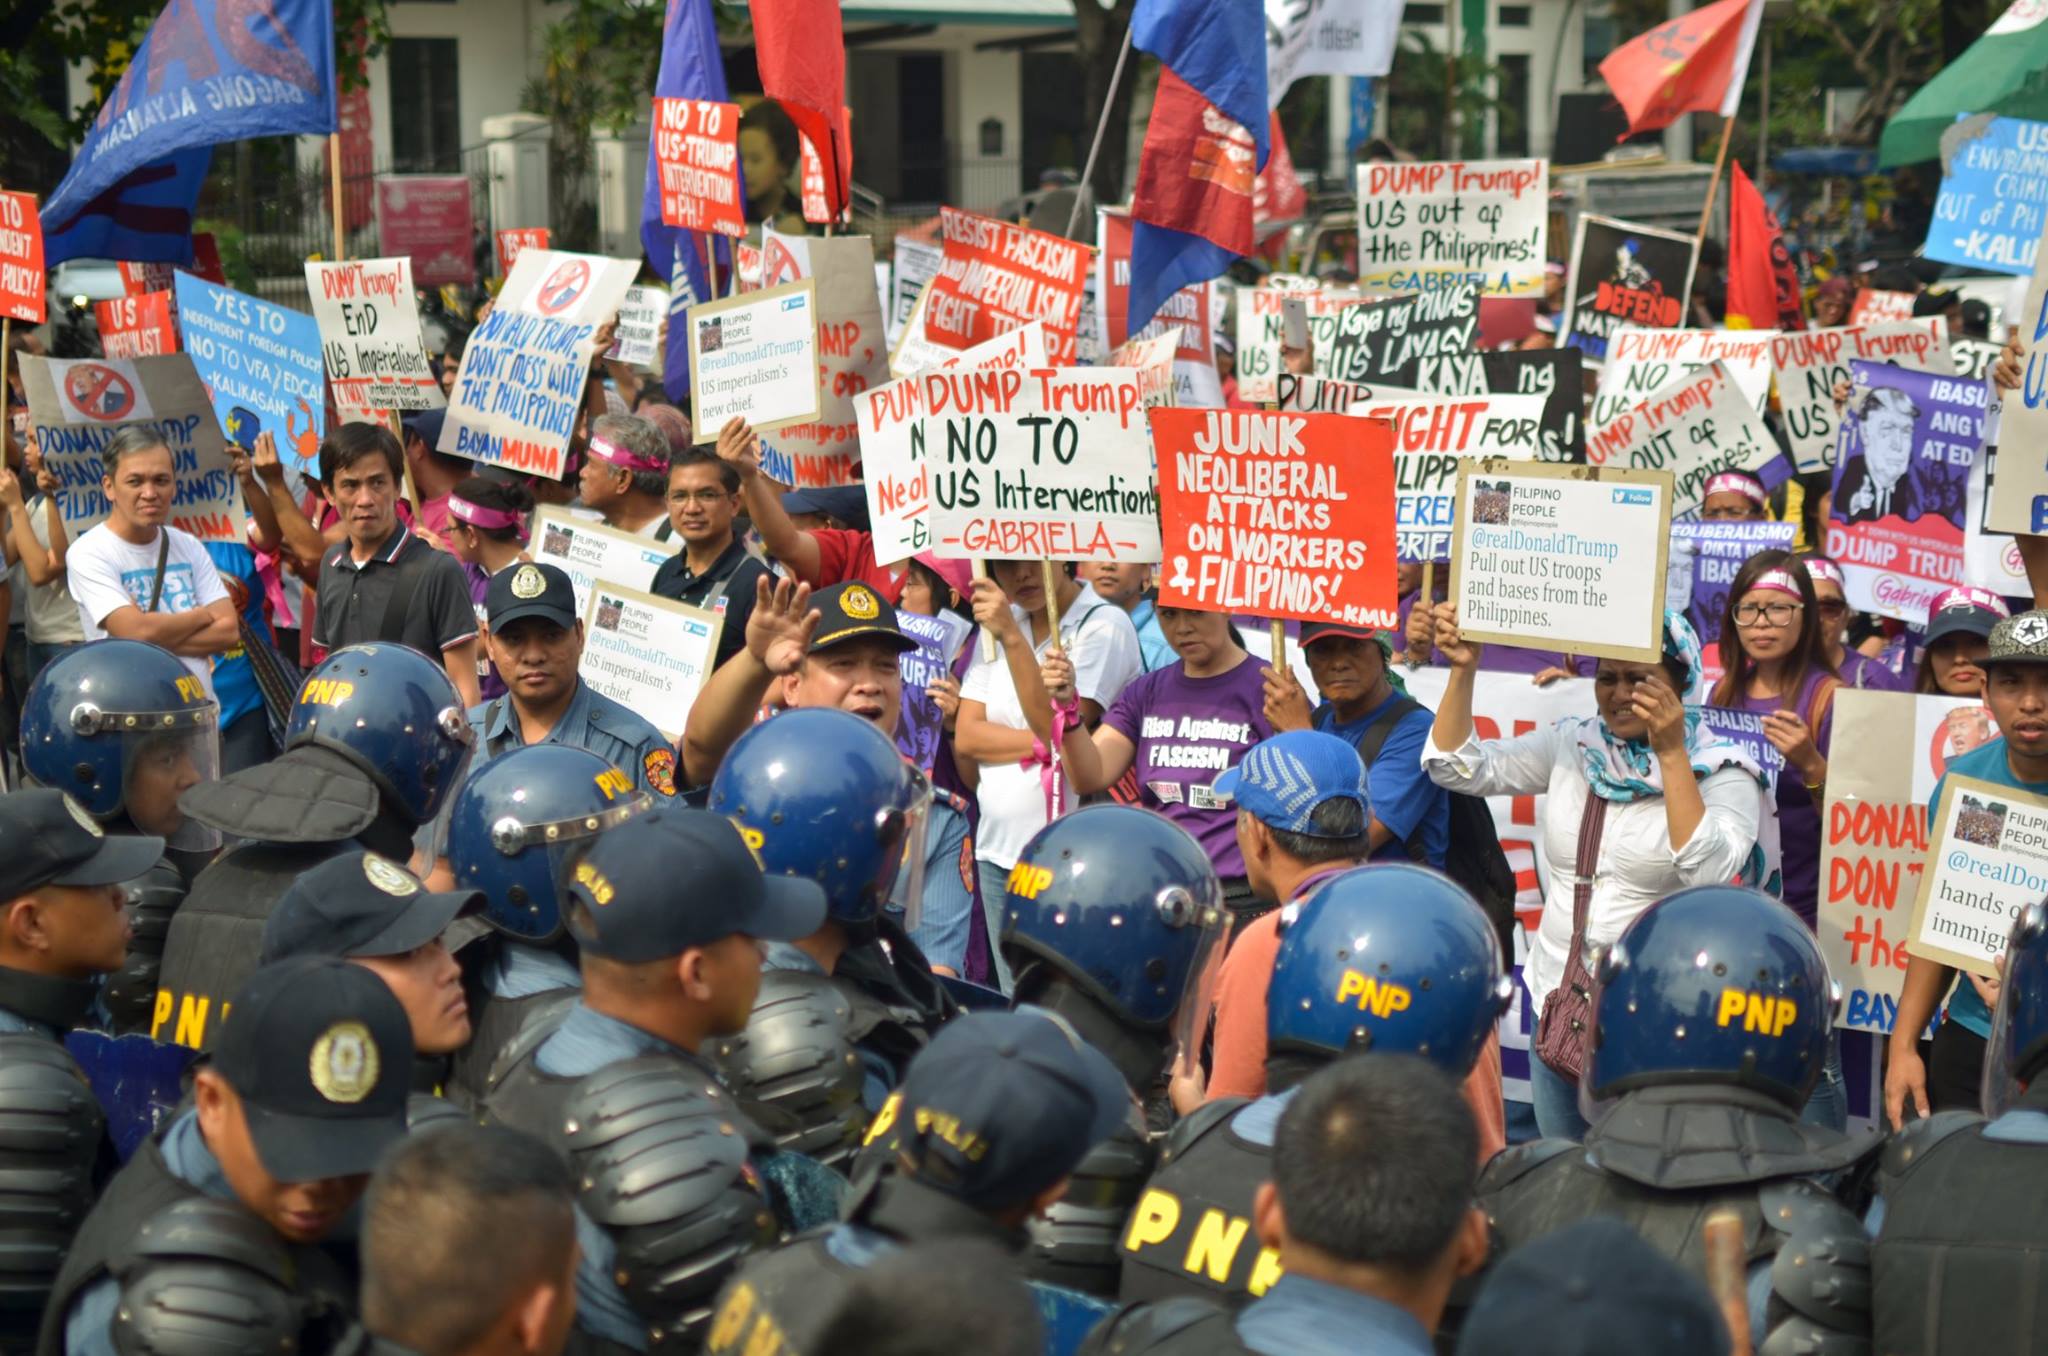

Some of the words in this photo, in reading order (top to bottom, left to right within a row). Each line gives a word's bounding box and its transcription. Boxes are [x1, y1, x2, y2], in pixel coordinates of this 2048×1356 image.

[662, 99, 690, 131] NO
[697, 101, 721, 136] TO
[1369, 163, 1445, 195] DUMP
[1449, 159, 1541, 201] Trump!
[0, 194, 23, 229] TO
[1364, 200, 1407, 230] US
[1417, 196, 1465, 226] out
[941, 210, 999, 253] RESIST
[1004, 227, 1076, 284] FASCISM
[1365, 230, 1412, 265] the
[1419, 226, 1540, 270] Philippines!
[1953, 229, 2041, 268] -KALI
[1, 262, 40, 299] POLICY!
[321, 265, 355, 299] DUMP
[939, 256, 966, 283] AND
[958, 258, 1080, 331] IMPERIALISM!
[110, 298, 138, 330] US
[207, 288, 250, 325] YES
[256, 305, 287, 337] TO
[722, 312, 752, 329] FILIPINO
[925, 288, 979, 339] FIGHT
[1339, 303, 1384, 345] Kaya
[1386, 303, 1413, 337] ng
[1414, 283, 1477, 323] PINAS
[1594, 280, 1682, 327] DEFEND
[183, 306, 245, 344] INDEPENDENT
[248, 333, 288, 360] FOREIGN
[474, 309, 538, 349] DONALD
[723, 325, 750, 339] PEOPLE
[1615, 332, 1693, 361] DUMP
[1771, 331, 1842, 371] DUMP
[1842, 318, 1941, 365] Trump!
[188, 331, 215, 360] NO
[218, 342, 241, 369] TO
[242, 354, 272, 384] VFA
[323, 341, 351, 379] US
[699, 337, 804, 372] @realDonaldTrump
[1330, 343, 1373, 381] US
[1951, 338, 2003, 381] ST
[547, 362, 585, 402] WITH
[700, 377, 716, 397] US
[717, 364, 788, 393] imperialism's
[1416, 354, 1490, 396] KAYA
[1517, 363, 1556, 394] ng
[1625, 361, 1669, 392] NO
[461, 379, 491, 412] THE
[702, 403, 724, 420] new
[726, 394, 755, 416] chief.
[925, 370, 1021, 417] DUMP
[1030, 368, 1143, 429] Trump!
[1929, 379, 1988, 410] IBASU
[1585, 415, 1634, 465] UMP
[1633, 362, 1726, 431] Trump!
[1787, 403, 1830, 440] US
[1930, 411, 1972, 437] ANG
[947, 416, 997, 465] NO
[1017, 416, 1079, 465] TO
[1193, 411, 1308, 457] JUNK
[1479, 418, 1537, 447] FOR
[1689, 417, 1719, 449] of
[1921, 439, 1947, 463] AT
[1947, 443, 1975, 468] ED
[46, 457, 106, 488] HAND
[935, 467, 981, 510] US
[995, 468, 1157, 515] Intervention!
[1176, 451, 1348, 501] NEOLIBERAL
[1206, 493, 1331, 531] ATTACKS
[1512, 503, 1557, 518] PEOPLE
[1513, 486, 1562, 502] FILIPINO
[574, 533, 608, 552] FILIPINO
[941, 518, 1138, 558] -GABRIELA-
[1187, 523, 1224, 553] ON
[1229, 525, 1367, 571] WORKERS
[1472, 527, 1619, 564] @realDonaldTrump
[1670, 522, 1796, 542] EOLIBERALISMO
[1702, 540, 1743, 560] DIKTA
[1826, 528, 1898, 568] DUMP
[572, 545, 603, 562] PEOPLE
[1470, 551, 1498, 572] Pull
[1501, 558, 1525, 576] out
[1529, 556, 1549, 578] US
[1553, 560, 1602, 587] troops
[1197, 554, 1343, 614] FILIPINOS!
[1467, 577, 1495, 598] and
[1499, 578, 1539, 602] bases
[1543, 582, 1579, 606] from
[1583, 586, 1608, 608] the
[620, 617, 649, 634] PEOPLE
[623, 605, 654, 623] FILIPINO
[1330, 603, 1398, 628] -KMU
[1467, 599, 1552, 629] Philippines.
[584, 650, 600, 668] US
[600, 656, 673, 693] imperialism's
[589, 631, 695, 678] @realDonaldTrump
[301, 677, 354, 708] PNP
[603, 677, 632, 704] chief.
[1141, 716, 1175, 739] Rise
[1177, 716, 1251, 744] Against
[1148, 745, 1230, 770] FASCISM
[1828, 800, 1930, 852] DONAL
[2004, 828, 2048, 851] PEOPL
[1004, 861, 1054, 901] PNP
[1938, 879, 2005, 916] hands
[1843, 914, 1909, 971] the
[1931, 911, 2009, 955] immigr
[1336, 968, 1412, 1020] PNP
[1716, 985, 1797, 1038] PNP
